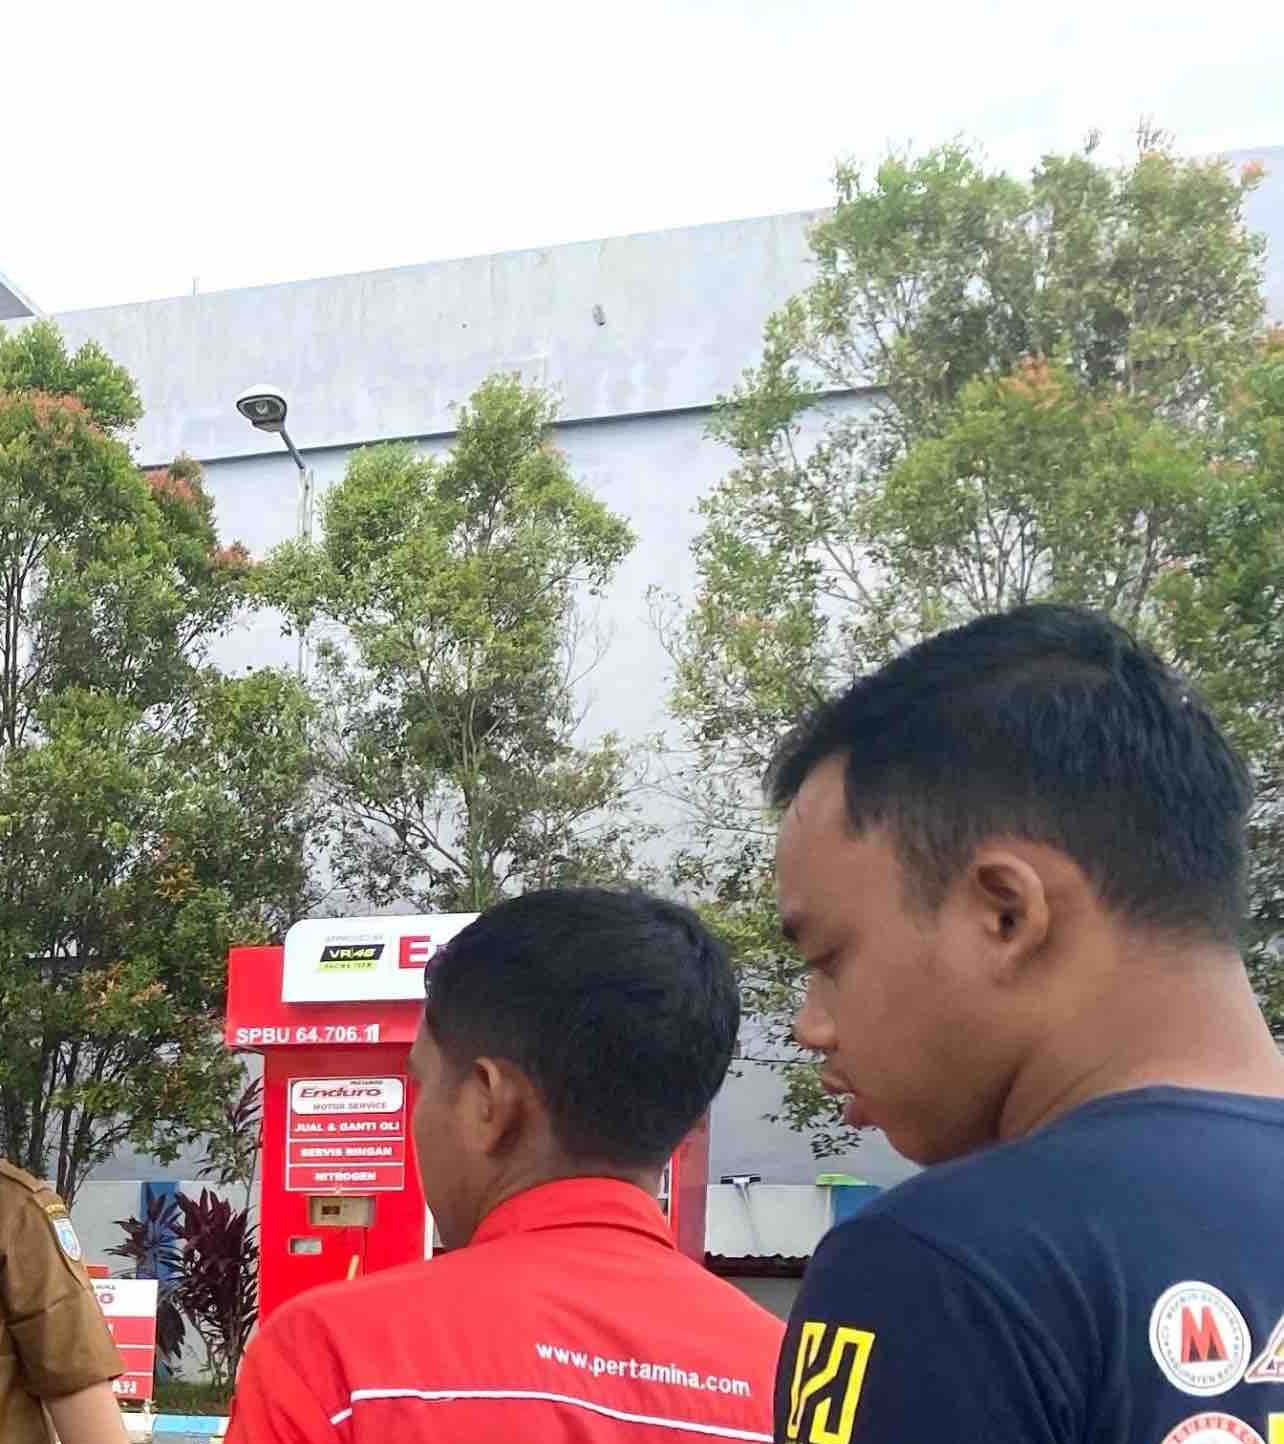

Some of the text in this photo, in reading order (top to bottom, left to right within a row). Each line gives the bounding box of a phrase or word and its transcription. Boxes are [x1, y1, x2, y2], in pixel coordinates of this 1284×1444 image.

[235, 1027, 290, 1044] SPBU
[299, 1087, 382, 1098] Enduro
[535, 1343, 751, 1397] www.pertamina.com
